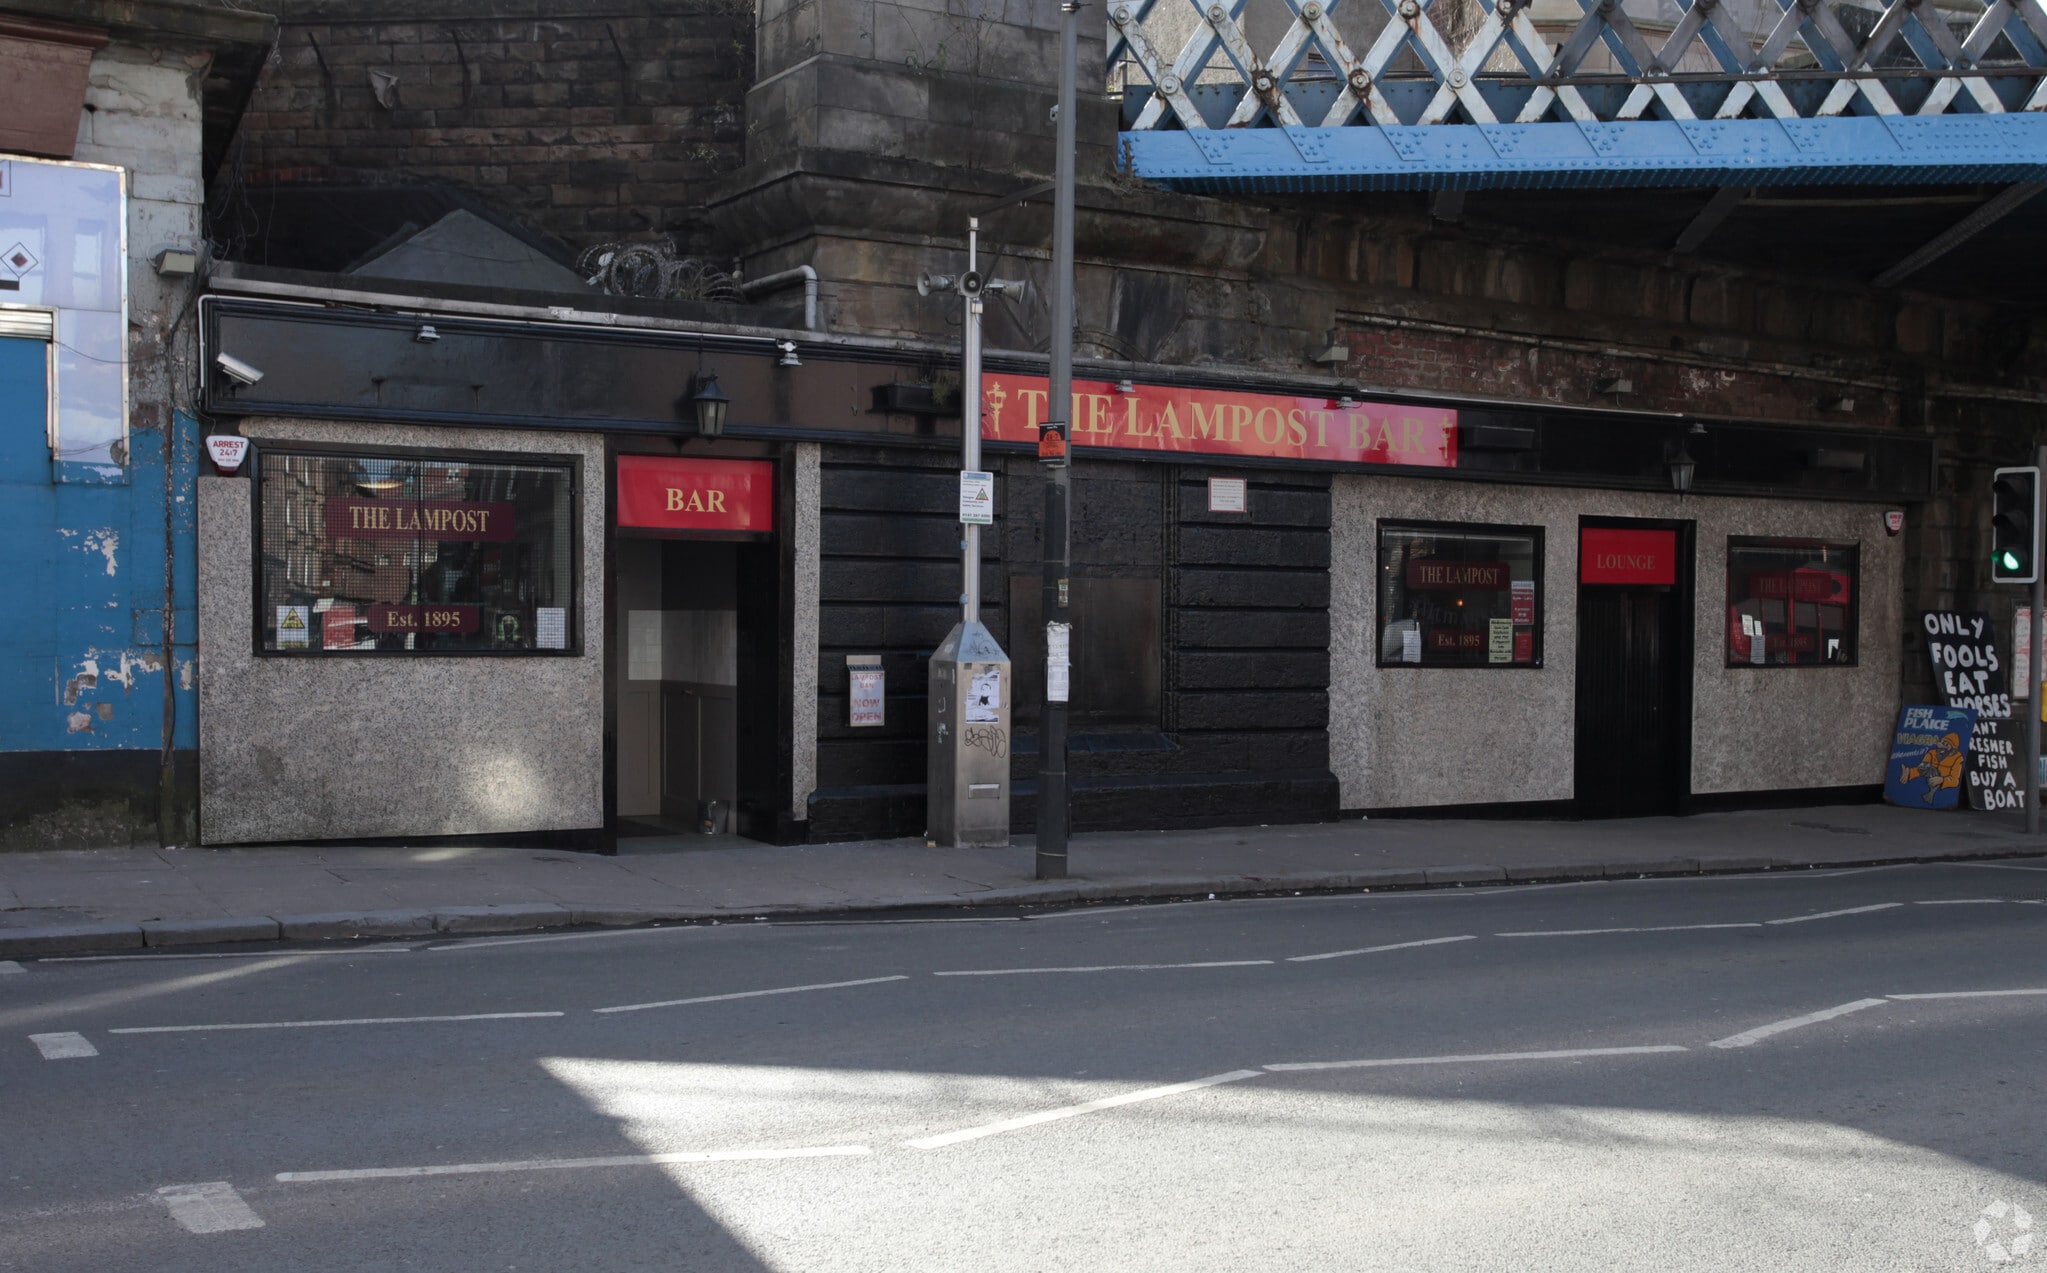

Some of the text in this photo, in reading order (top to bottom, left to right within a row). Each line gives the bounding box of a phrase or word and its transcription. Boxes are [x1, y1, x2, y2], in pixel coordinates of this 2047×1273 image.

[1124, 397, 1335, 448] LAMPOST
[1347, 413, 1426, 454] BAR
[213, 440, 245, 448] ARREST
[665, 488, 728, 513] BAR
[349, 506, 490, 532] THE LAMPOST
[1596, 553, 1656, 570] LOUNGE
[1420, 565, 1499, 585] THE LAMPOST
[387, 610, 461, 627] Est. 1895
[1924, 613, 1985, 640] ONLY
[1439, 633, 1480, 648] Est. 1895
[1931, 642, 2000, 672] FOOLS
[1944, 670, 1989, 695] EAT
[853, 698, 880, 708] NOW
[852, 712, 881, 721] OPEN
[1907, 707, 1934, 719] FISH
[1904, 717, 1950, 731] PLAICE
[1972, 721, 1998, 735] ANT
[1897, 732, 1939, 746] VIAGRA
[1968, 736, 2014, 756] RESHER
[1977, 754, 2008, 770] FISH
[1970, 770, 2017, 788] BUY A
[1983, 788, 2025, 811] BOAT
